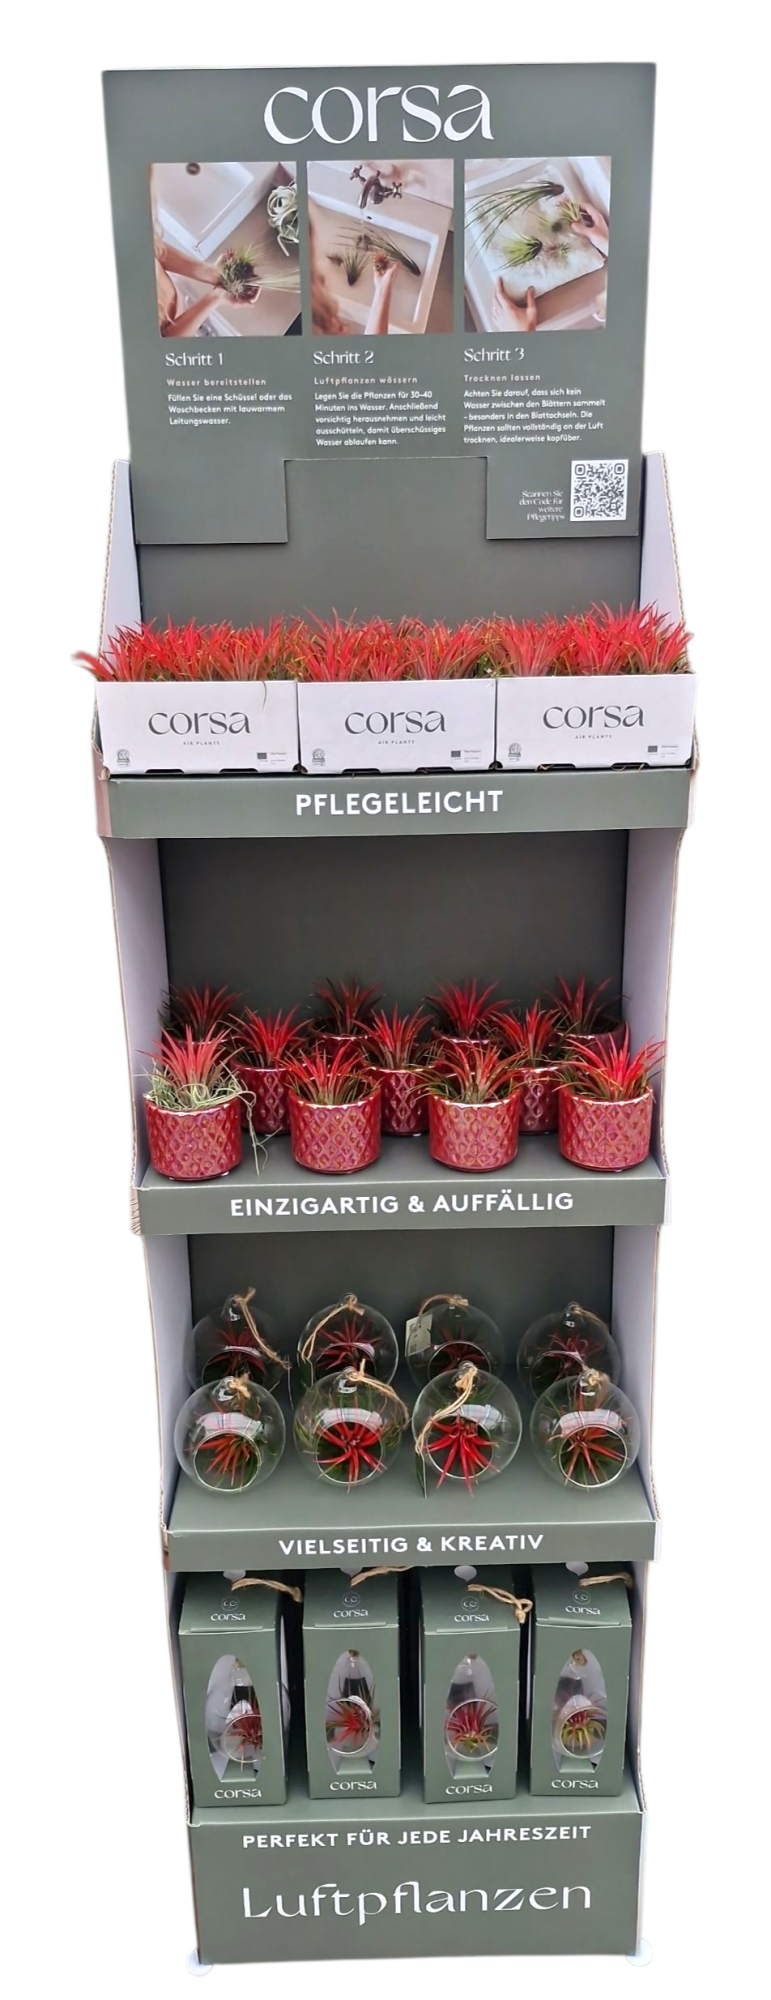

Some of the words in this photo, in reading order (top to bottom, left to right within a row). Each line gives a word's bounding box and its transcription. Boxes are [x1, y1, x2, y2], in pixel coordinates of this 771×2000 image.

[263, 84, 495, 145] corsa
[166, 352, 213, 366] Schritt
[218, 352, 223, 366] 1
[313, 351, 360, 365] Schritt
[364, 350, 374, 364] 2
[464, 348, 511, 362] Schritt
[515, 347, 525, 361] 3
[204, 378, 266, 386] bereitstellen
[314, 376, 375, 387] Luftpflanzen
[379, 376, 418, 385] wässern
[463, 374, 507, 382] Trocknen
[224, 393, 257, 401] Schüssel
[259, 393, 277, 401] oder
[279, 393, 292, 401] das
[315, 392, 337, 401] Legen
[338, 392, 349, 400] Sie
[351, 392, 362, 400] die
[364, 391, 396, 400] Pflanzen
[398, 391, 409, 399] für
[410, 391, 433, 399] 30–40
[491, 389, 501, 397] Sie
[503, 389, 530, 398] darauf,
[550, 388, 565, 396] sich
[169, 405, 221, 413] Waschbecken
[223, 405, 237, 413] mit
[239, 404, 285, 413] lauwarmem
[315, 403, 345, 411] Minuten
[347, 403, 358, 411] ins
[360, 403, 388, 411] Wasser.
[389, 403, 438, 411] Anschließend
[464, 401, 490, 409] Wasser
[491, 400, 524, 408] zwischen
[526, 400, 540, 408] den
[315, 415, 351, 424] vorsichtig
[353, 414, 407, 423] herausnehmen
[409, 414, 423, 422] und
[425, 413, 446, 422] leicht
[469, 413, 505, 421] besonders
[507, 412, 514, 420] in
[516, 412, 529, 420] den
[531, 411, 579, 419] Blattachseln.
[170, 417, 231, 426] Leitungswasser.
[316, 426, 365, 436] ausschütteln,
[367, 426, 389, 434] damit
[391, 425, 446, 435] überschüssiges
[464, 424, 495, 432] Pflanzen
[497, 424, 521, 432] sollten
[522, 423, 561, 432] vollständig
[574, 422, 586, 430] der
[316, 438, 342, 446] Wasser
[344, 437, 376, 446] ablaufen
[378, 437, 399, 445] kann.
[464, 436, 498, 444] trocknen,
[499, 435, 545, 443] idealerweise
[547, 434, 582, 444] kopfüber.
[542, 704, 645, 730] corsa
[147, 710, 252, 736] corsa
[344, 710, 447, 735] corsa
[295, 789, 504, 816] PFLEGELEICHT
[230, 1196, 399, 1217] EINZIGARTIG
[407, 1195, 425, 1214] &
[432, 1189, 574, 1213] AUFFÄLLIG
[278, 1538, 409, 1556] VIELSEITIG
[417, 1536, 432, 1552] &
[441, 1534, 544, 1552] KREATIV
[333, 1609, 368, 1618] corsa
[565, 1605, 601, 1615] corsa
[210, 1613, 246, 1622] corsa
[454, 1614, 490, 1623] corsa
[330, 1780, 376, 1791] corsa
[552, 1779, 598, 1789] corsa
[215, 1788, 261, 1799] corsa
[446, 1784, 492, 1795] corsa
[243, 1834, 338, 1848] PERFEKT
[347, 1829, 390, 1845] FÜR
[398, 1831, 450, 1844] JEDE
[458, 1826, 591, 1842] JAHRESZEIT
[243, 1881, 590, 1925] Luftpflanzen
